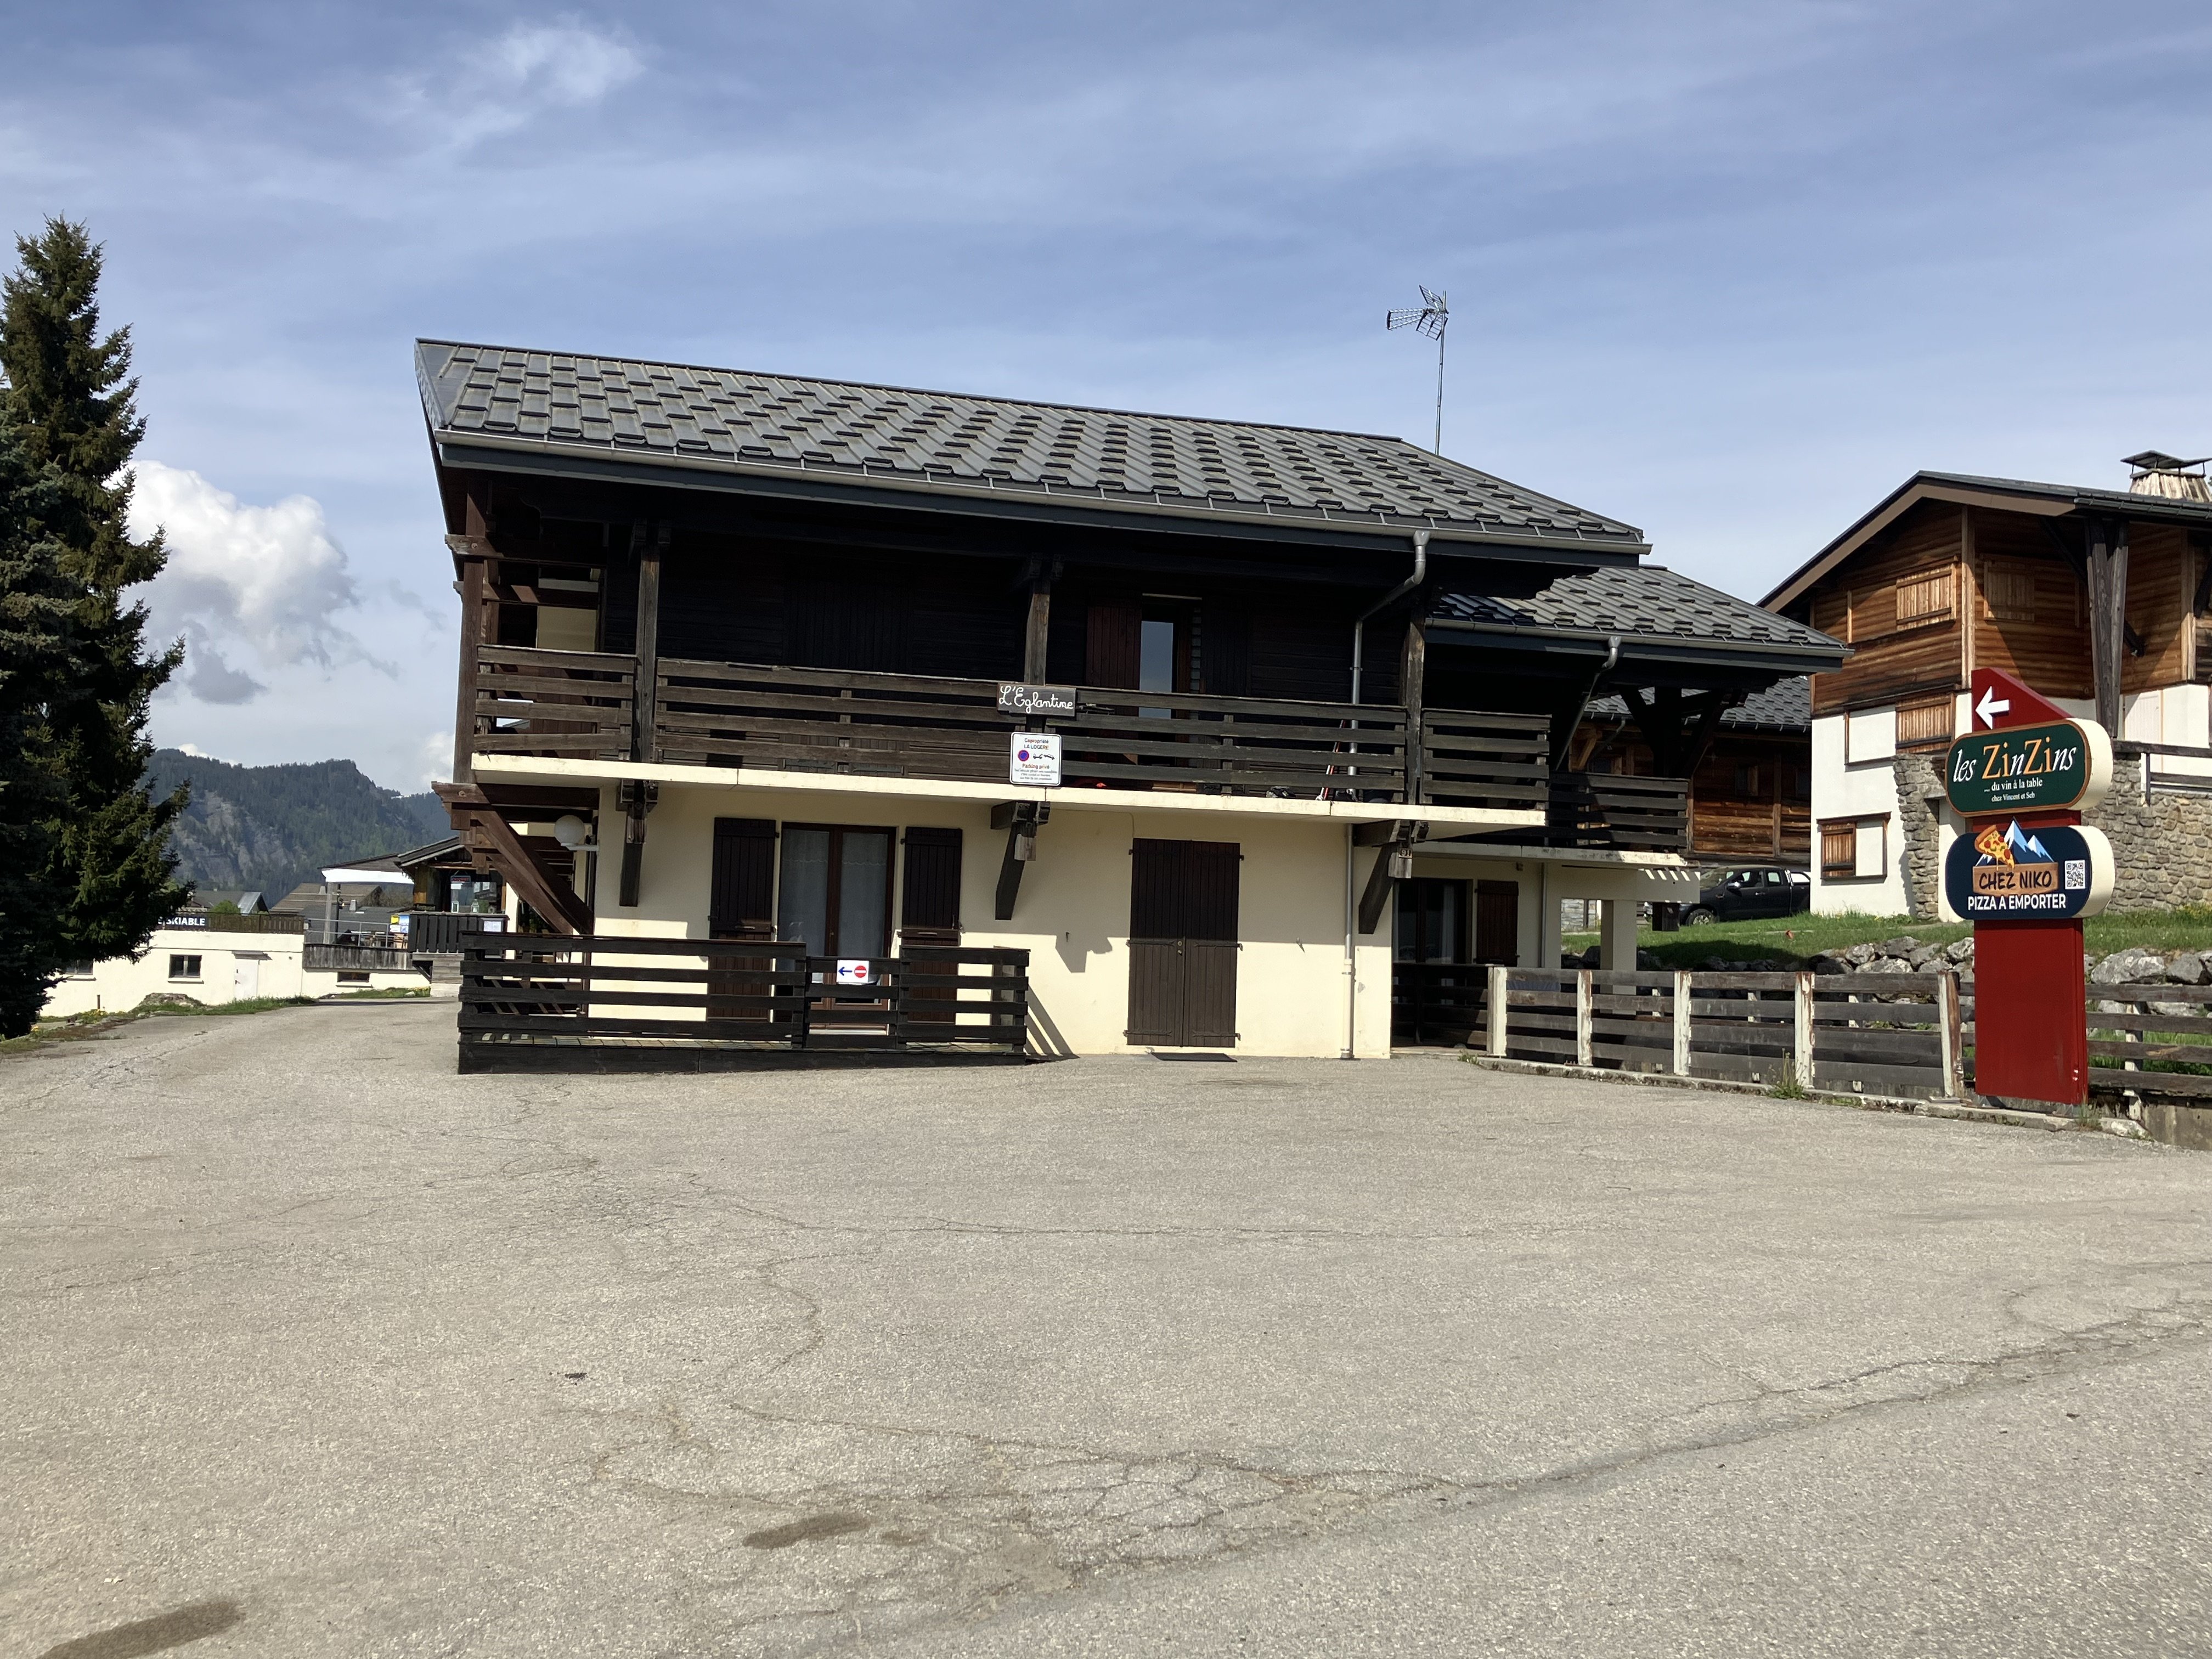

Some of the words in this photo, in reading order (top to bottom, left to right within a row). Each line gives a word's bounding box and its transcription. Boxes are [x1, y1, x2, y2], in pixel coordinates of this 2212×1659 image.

[998, 685, 1074, 714] L'Eglantine
[1953, 749, 1977, 782] les
[1982, 736, 2077, 779] ZinZins
[1991, 781, 2000, 792] du
[2001, 780, 2012, 790] vin
[2019, 777, 2025, 789] la
[2026, 777, 2043, 788] table
[1979, 872, 2016, 890] CHEZ
[2019, 871, 2052, 888] NIKO
[1967, 896, 1997, 910] PIZZA
[1999, 895, 2009, 910] A
[2009, 893, 2067, 909] EMPORTER
